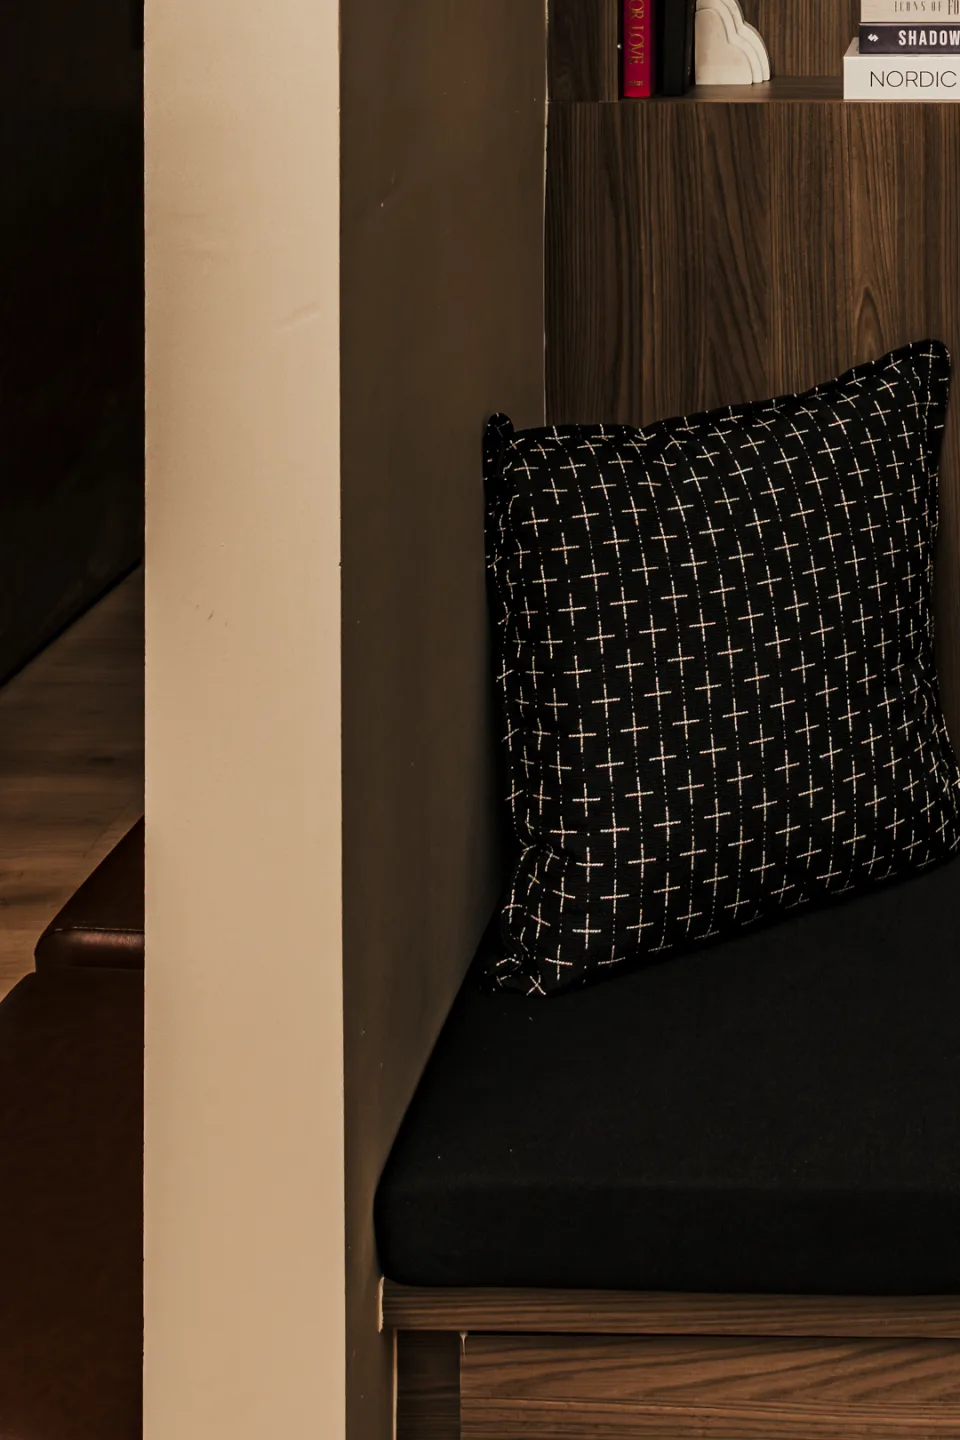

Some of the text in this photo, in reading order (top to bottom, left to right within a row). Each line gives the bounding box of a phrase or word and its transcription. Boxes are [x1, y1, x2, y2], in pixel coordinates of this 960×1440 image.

[894, 1, 926, 12] ICONS
[931, 1, 942, 11] OF
[629, 25, 645, 64] LOVE
[898, 30, 960, 45] SHADOW
[870, 71, 957, 88] NORDIC
